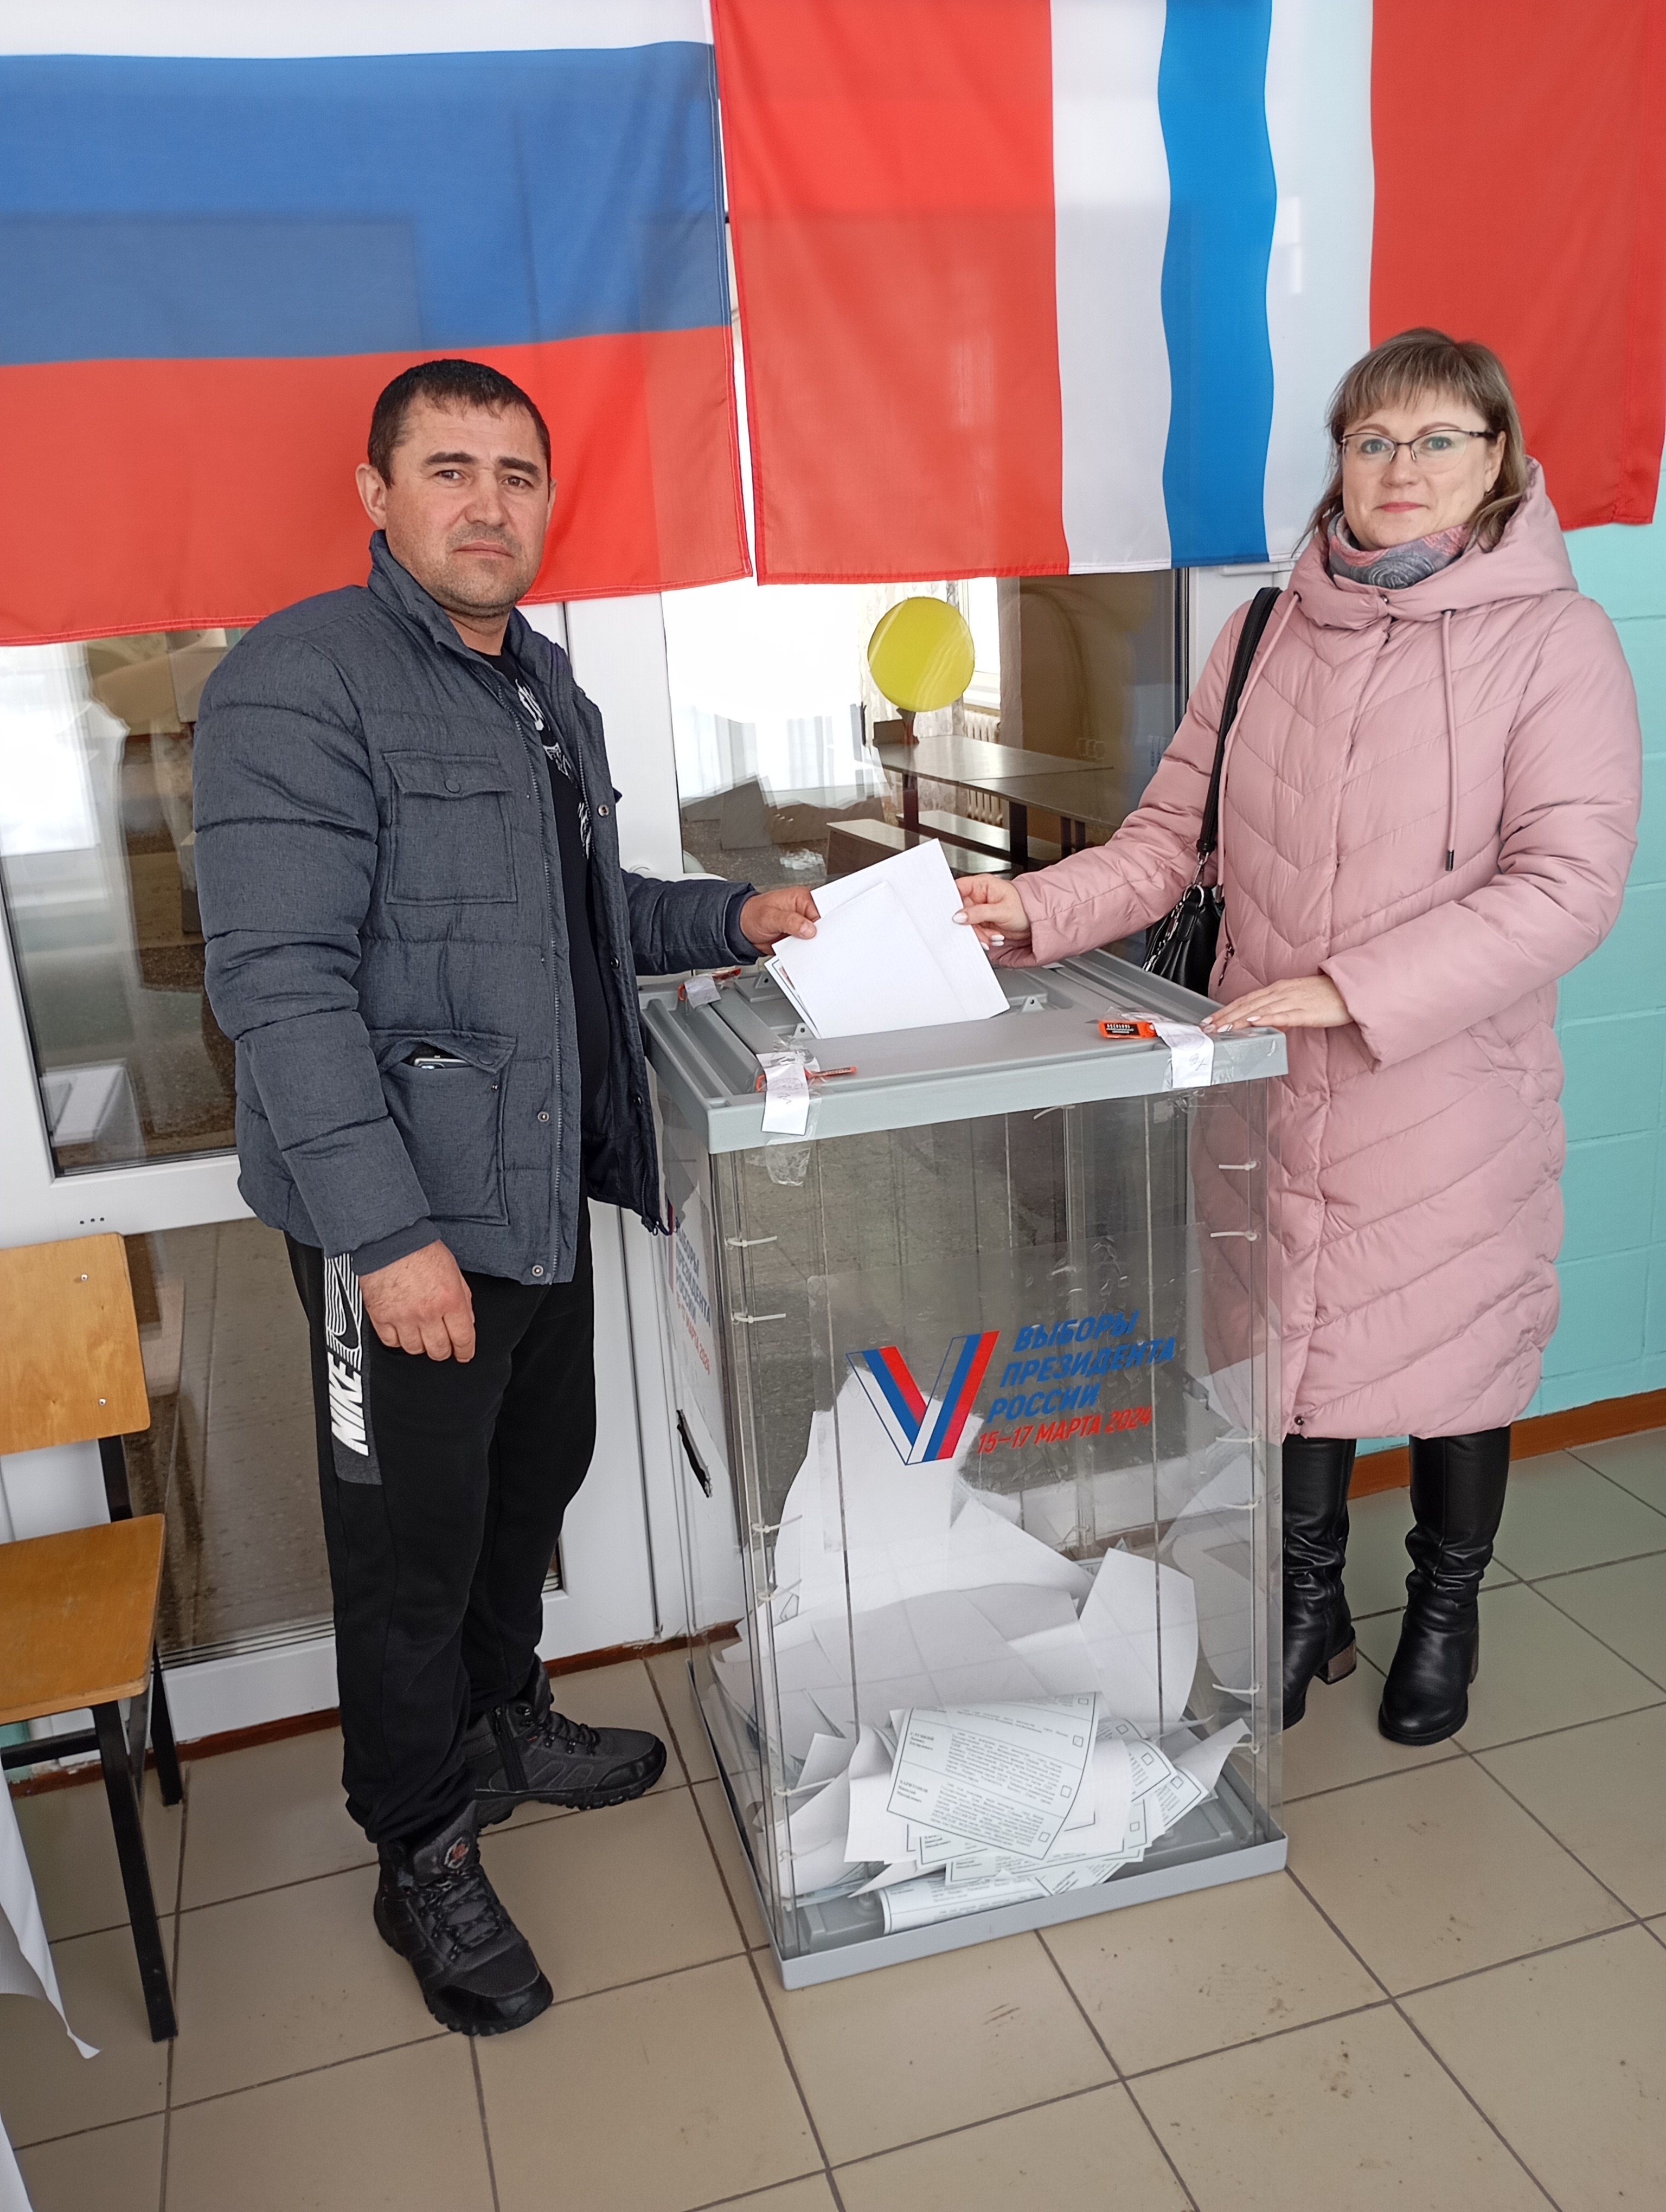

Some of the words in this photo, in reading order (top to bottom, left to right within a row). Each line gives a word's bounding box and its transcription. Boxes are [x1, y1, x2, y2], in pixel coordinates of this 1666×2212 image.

[1014, 1310, 1139, 1352] ВЫБОРЫ
[1000, 1337, 1175, 1387] ПРЕЗИДЕНТА
[328, 1352, 369, 1456] NIKE
[986, 1382, 1101, 1423] РОССИИ
[1035, 1413, 1101, 1444] МАРТА
[1105, 1405, 1152, 1433] 2024
